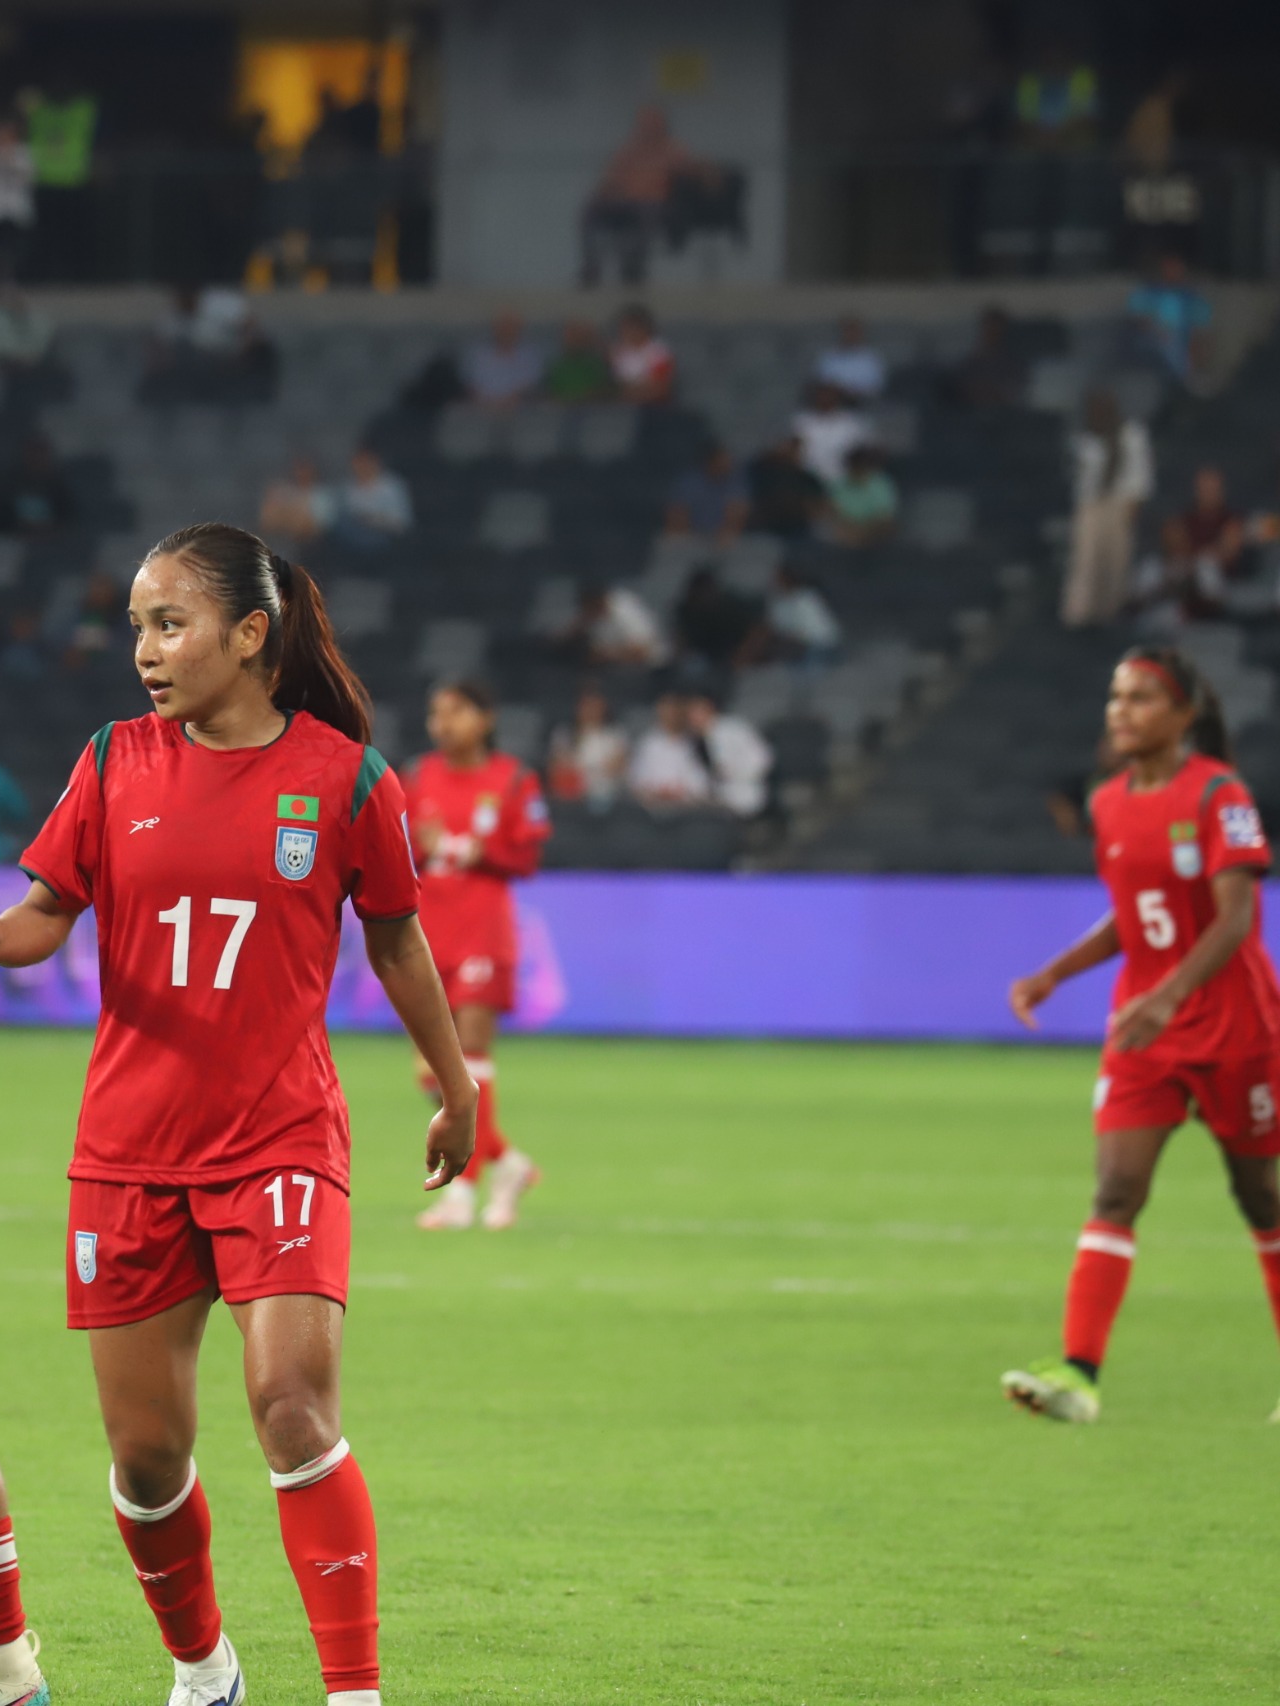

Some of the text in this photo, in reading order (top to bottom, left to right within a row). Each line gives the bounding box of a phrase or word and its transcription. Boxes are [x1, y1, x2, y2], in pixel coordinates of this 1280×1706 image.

[158, 895, 257, 990] 17
[1136, 889, 1176, 949] 5
[1249, 1084, 1275, 1121] 5
[264, 1174, 315, 1227] 17
